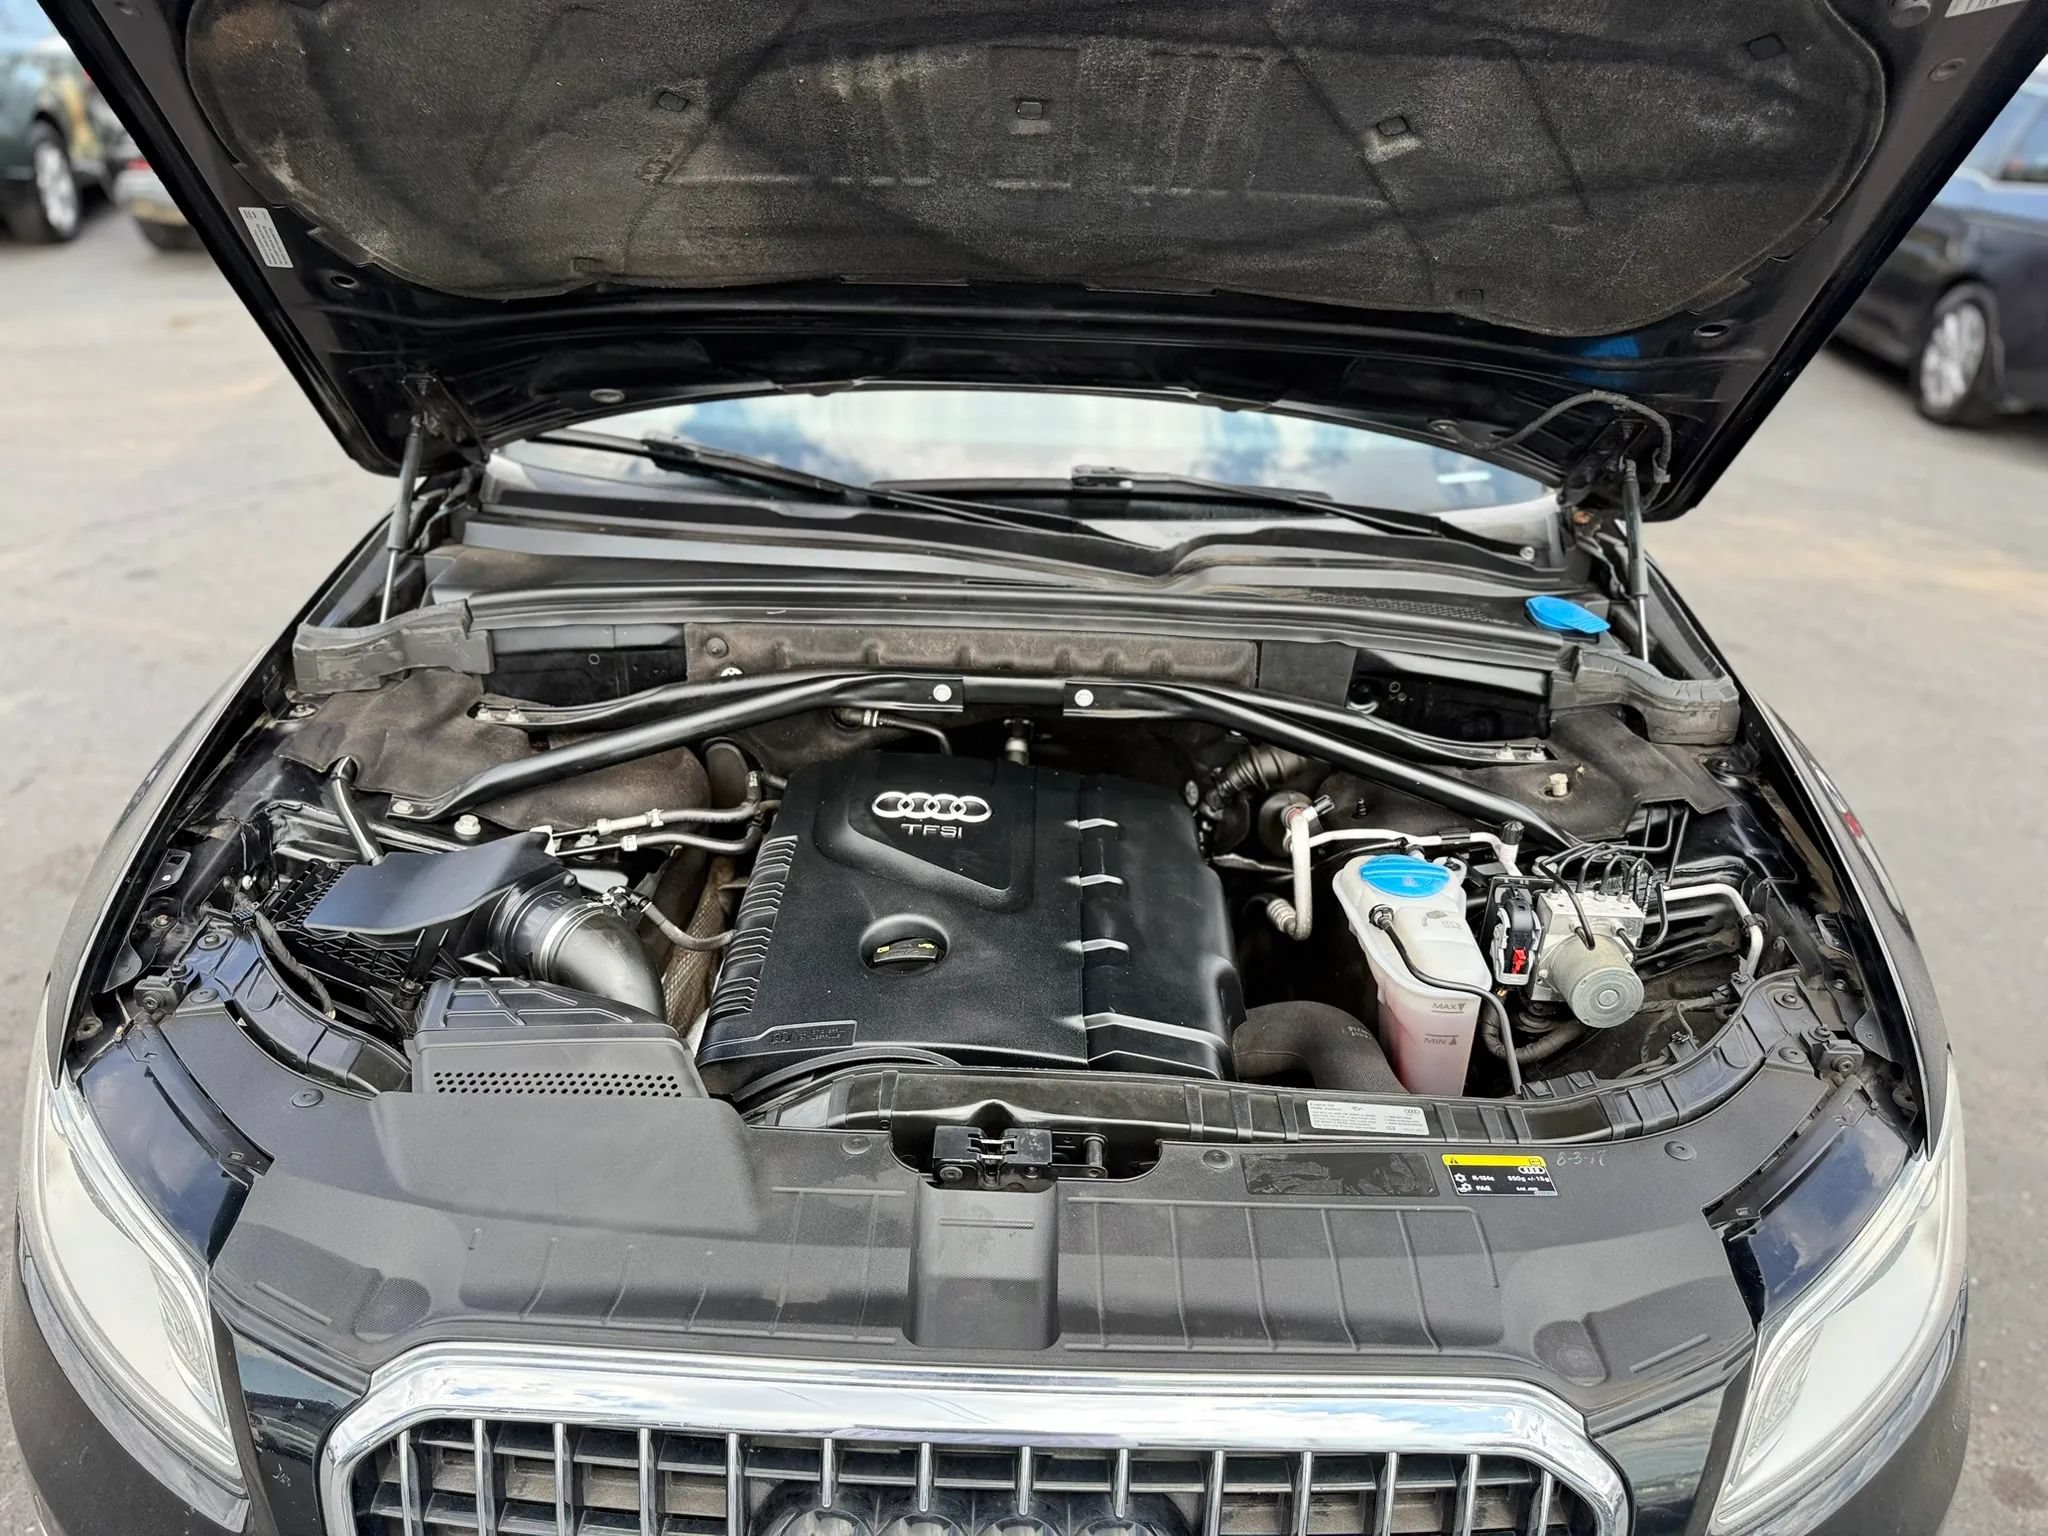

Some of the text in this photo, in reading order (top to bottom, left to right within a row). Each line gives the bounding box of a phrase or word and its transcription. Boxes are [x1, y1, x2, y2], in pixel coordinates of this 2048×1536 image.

[901, 823, 963, 839] TFSI
[1432, 1002, 1457, 1010] MAX
[1424, 1037, 1446, 1045] MIN
